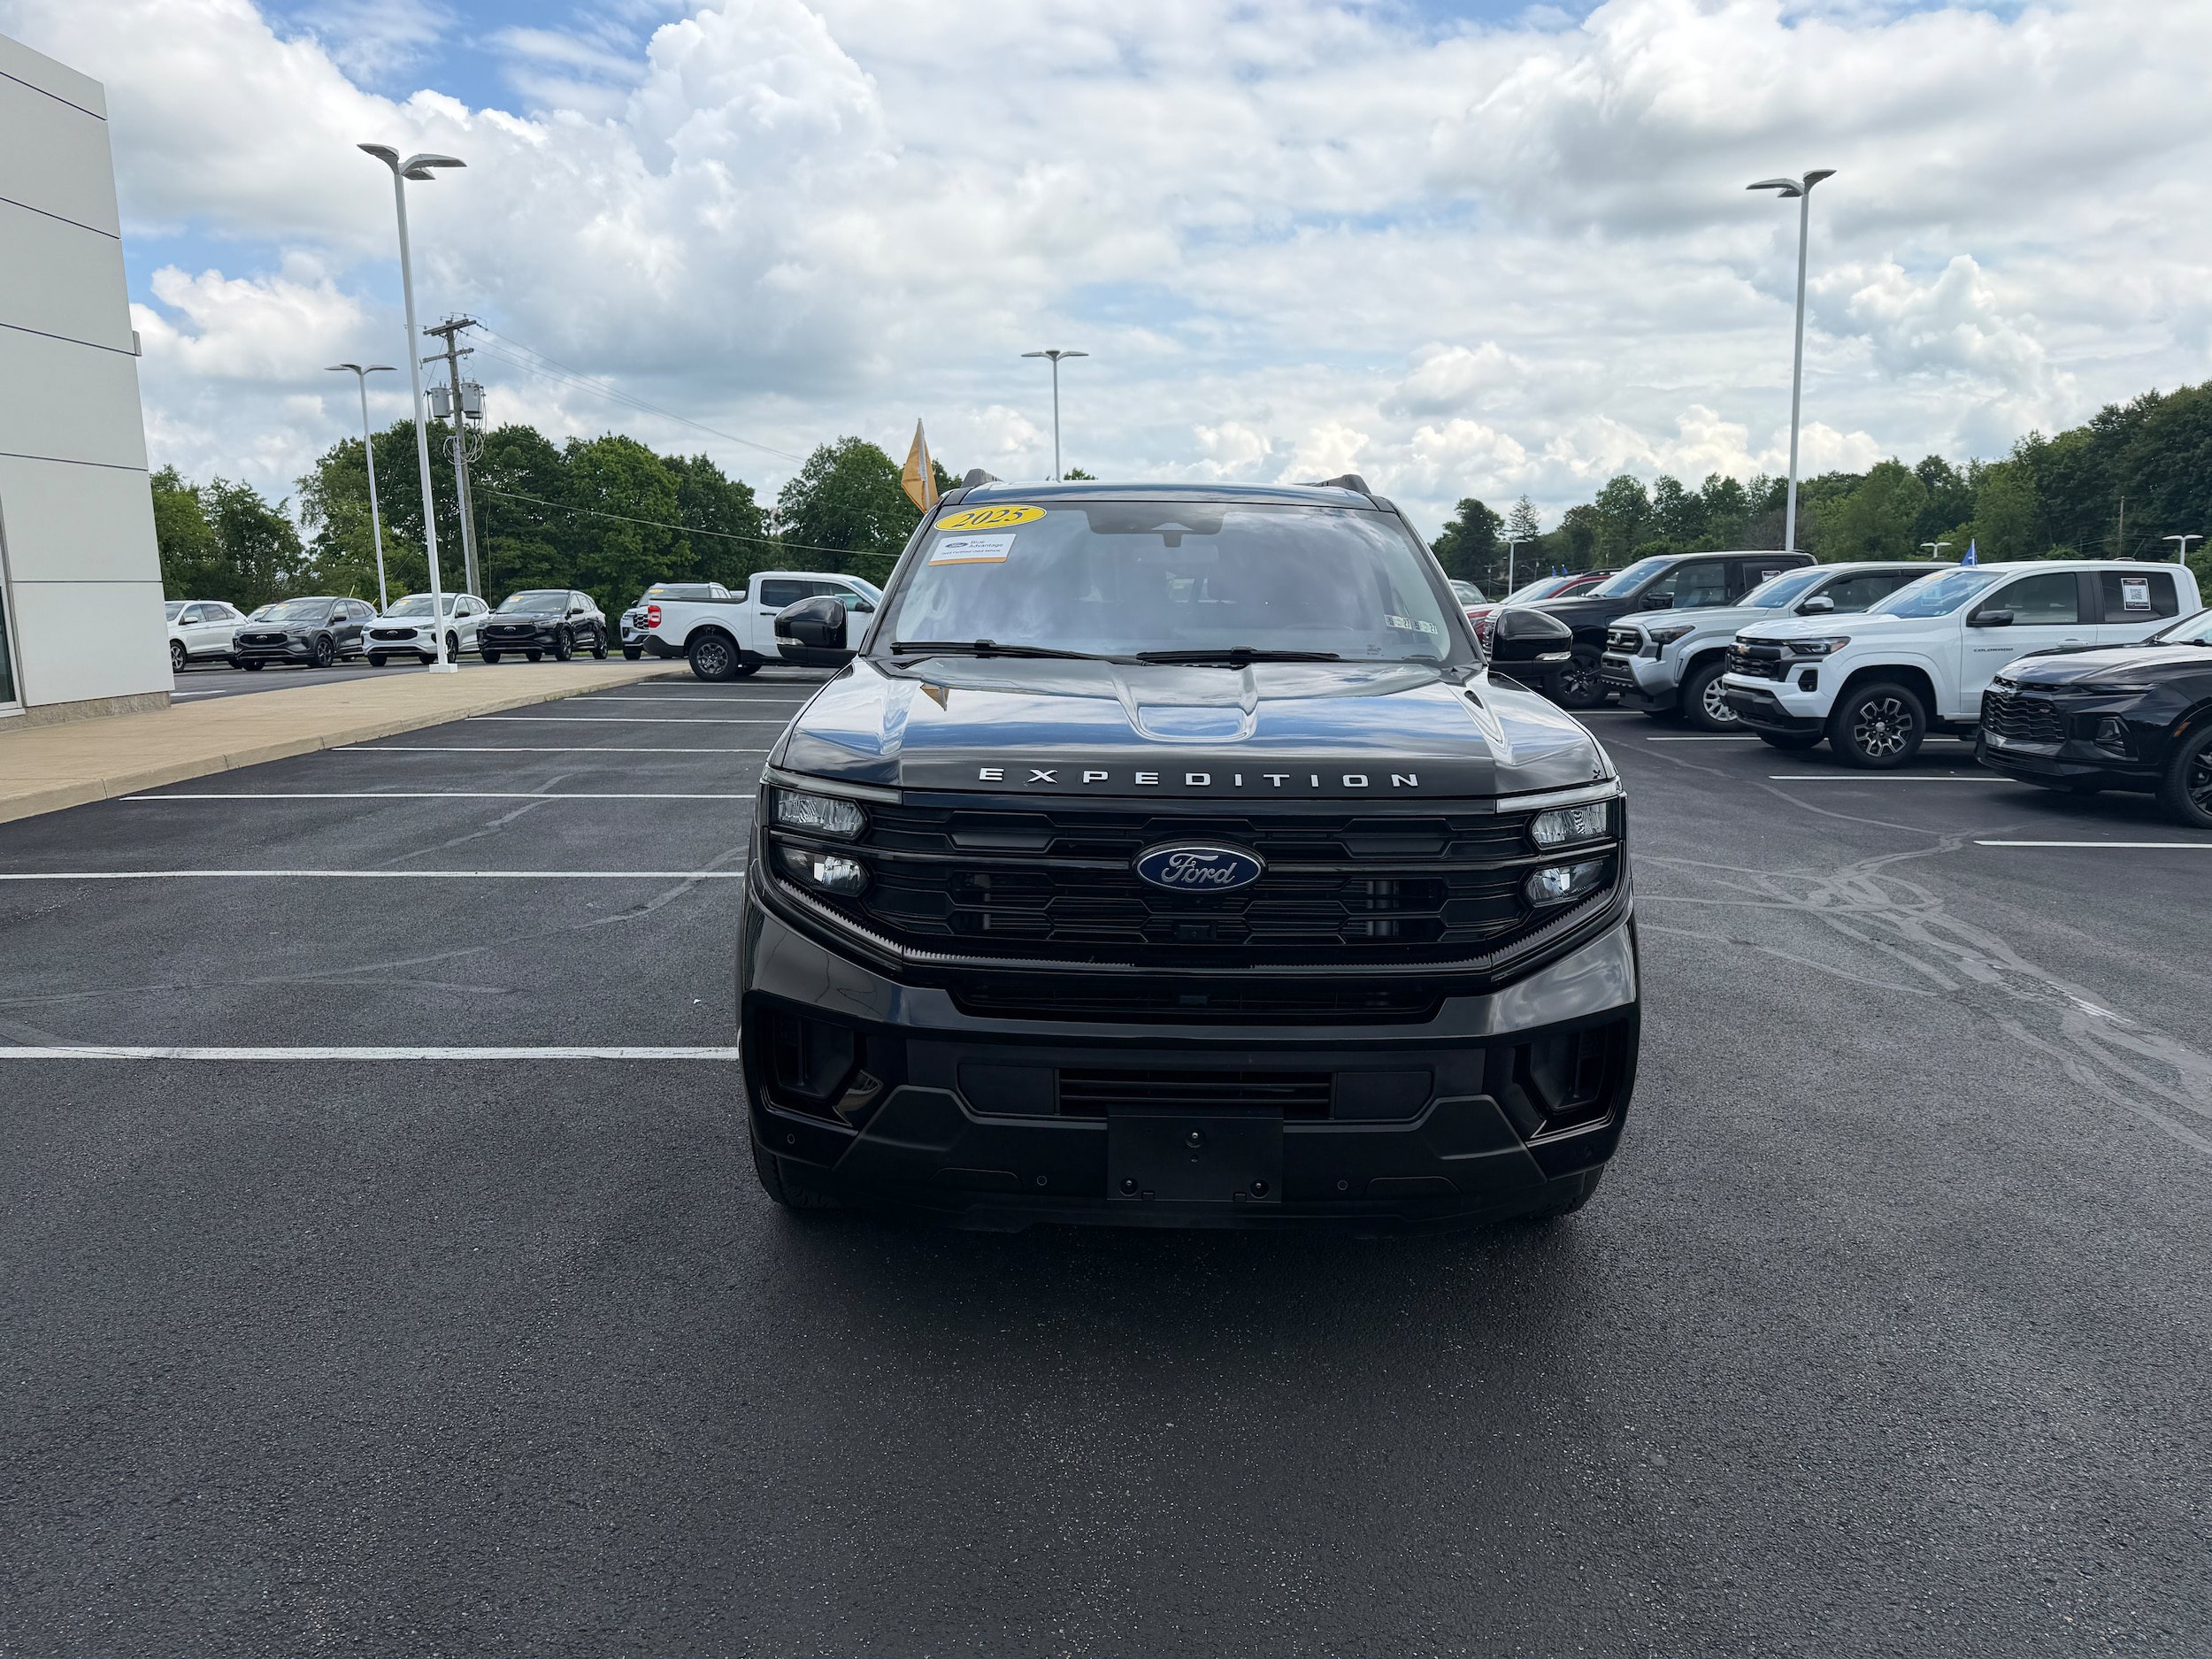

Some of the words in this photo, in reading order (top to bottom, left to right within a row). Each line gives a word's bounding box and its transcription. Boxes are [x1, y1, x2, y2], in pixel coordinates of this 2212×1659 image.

[951, 508, 1029, 528] 2025
[979, 767, 1419, 788] EXPEDITION
[1160, 852, 1238, 886] Ford
